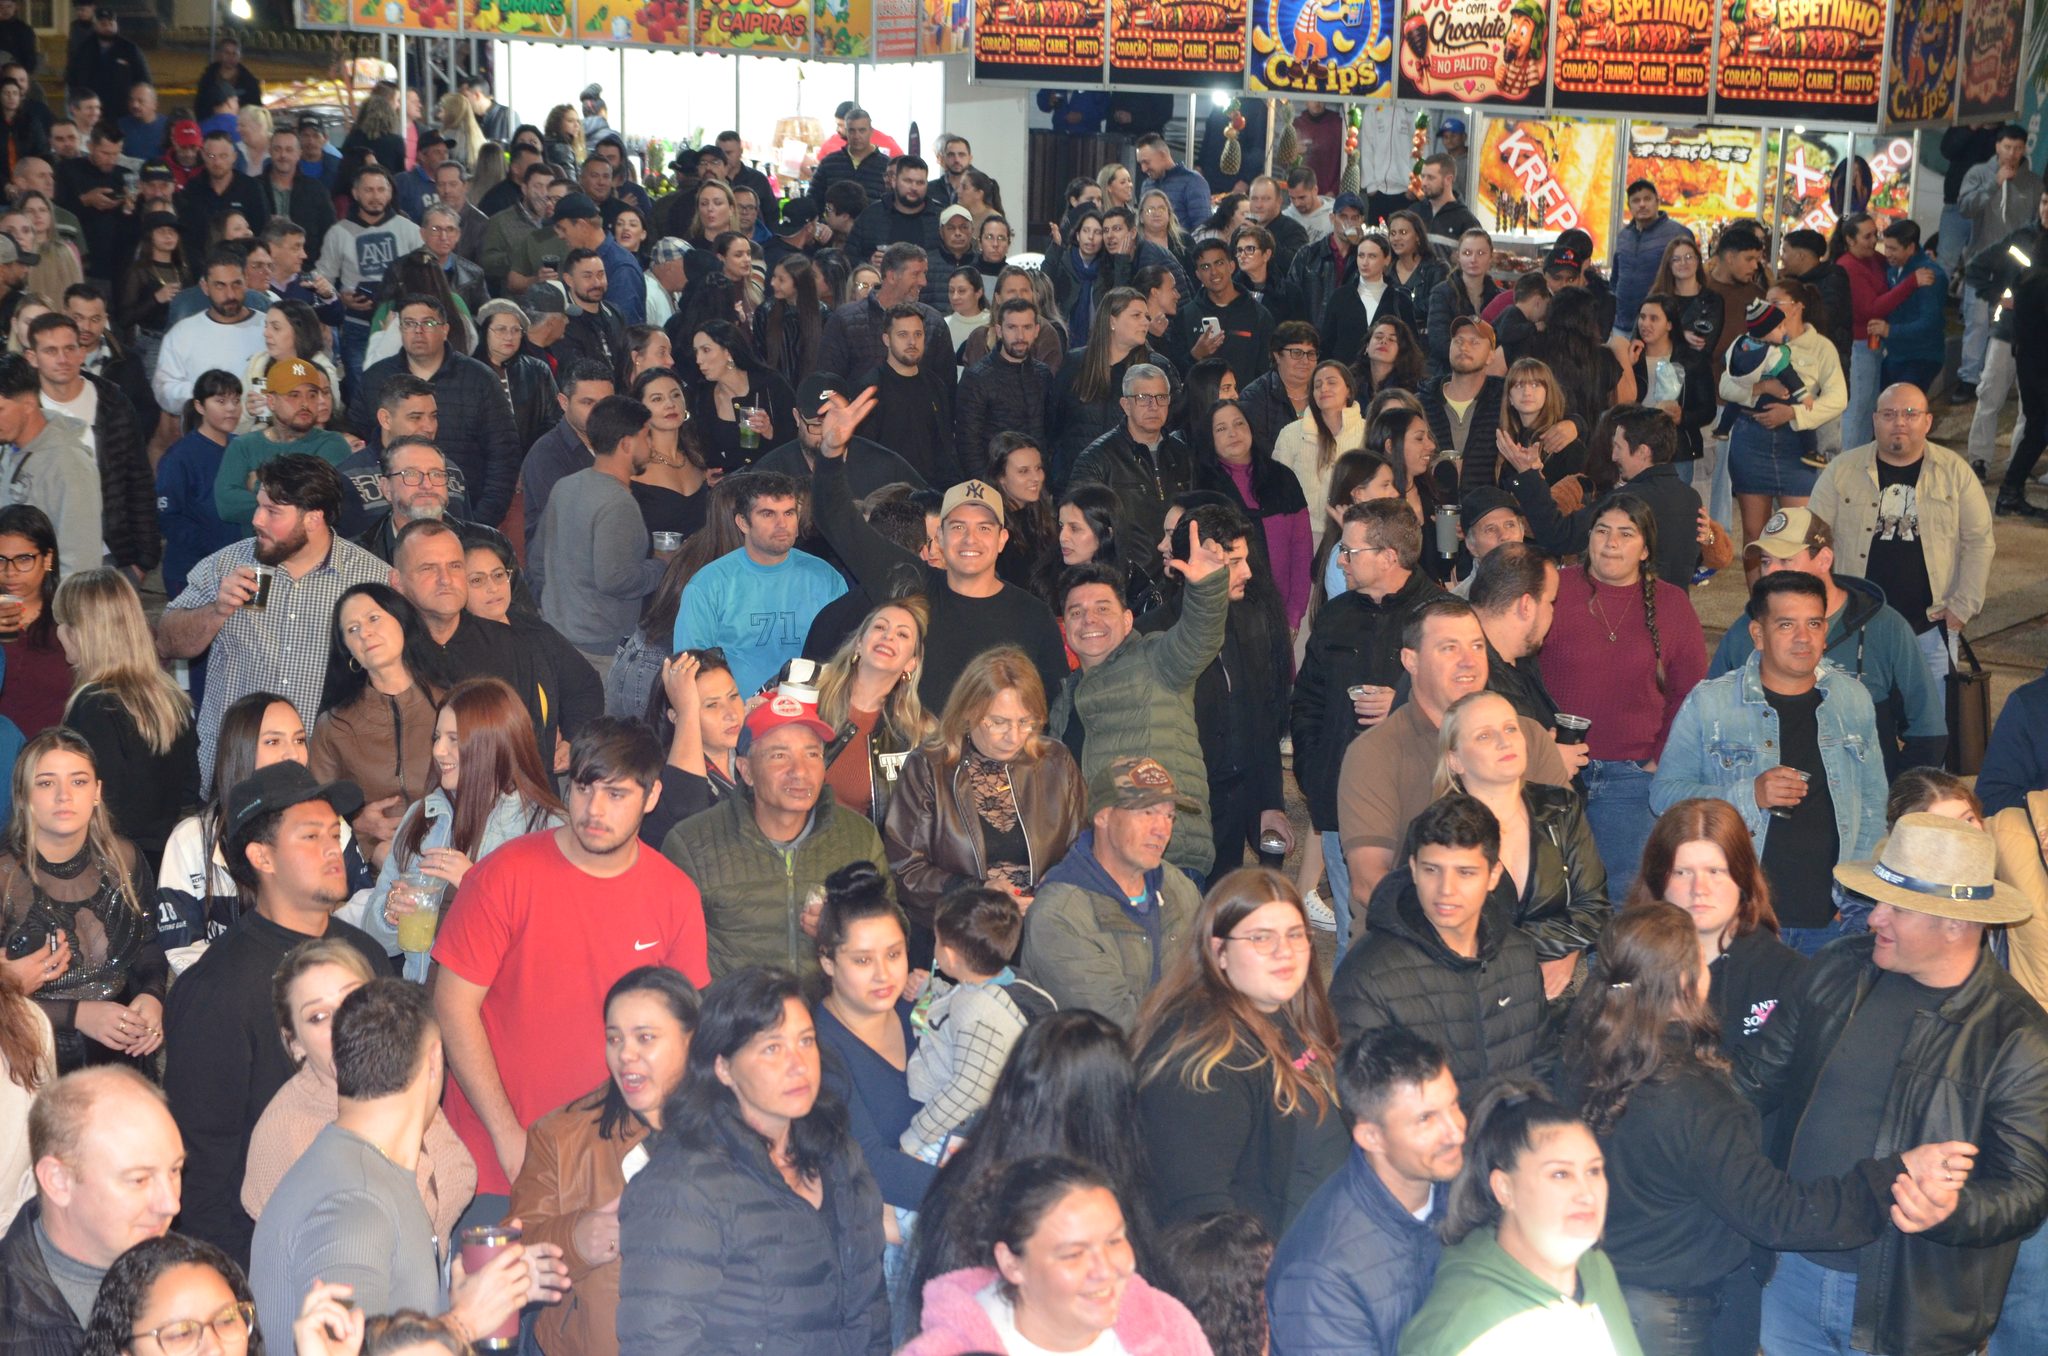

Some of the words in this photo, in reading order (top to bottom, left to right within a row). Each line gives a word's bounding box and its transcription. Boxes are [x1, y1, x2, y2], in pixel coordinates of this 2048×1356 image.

[1465, 3, 1487, 14] com
[1779, 0, 1880, 37] ESPETINHO
[698, 9, 712, 31] E
[718, 11, 807, 36] CAIPIRAS
[1429, 11, 1506, 45] Chocolate
[981, 36, 1011, 54] CORAÇÃO
[1016, 38, 1041, 52] FRANGO
[1045, 39, 1069, 53] CARNE
[1075, 40, 1099, 55] MISTO
[1116, 40, 1147, 59] CORAÇÃO
[1152, 42, 1178, 58] FRANGO
[1183, 44, 1207, 59] CARNE
[1215, 45, 1239, 60] MISTO
[1437, 61, 1451, 75] NO
[1454, 59, 1488, 72] PALITO
[1562, 60, 1598, 82] CORAÇÃO
[1604, 64, 1634, 80] FRANGO
[1640, 66, 1667, 82] CARNE
[1676, 67, 1704, 83] MISTO
[1723, 66, 1762, 87] CORAÇÃO
[1768, 70, 1799, 87] FRANGO
[1806, 71, 1834, 90] CARNE
[1843, 73, 1874, 91] MISTO
[1499, 129, 1591, 238] KREP
[1785, 146, 1825, 199] X
[966, 482, 984, 499] NY
[751, 611, 801, 647] 71
[159, 902, 178, 923] 18
